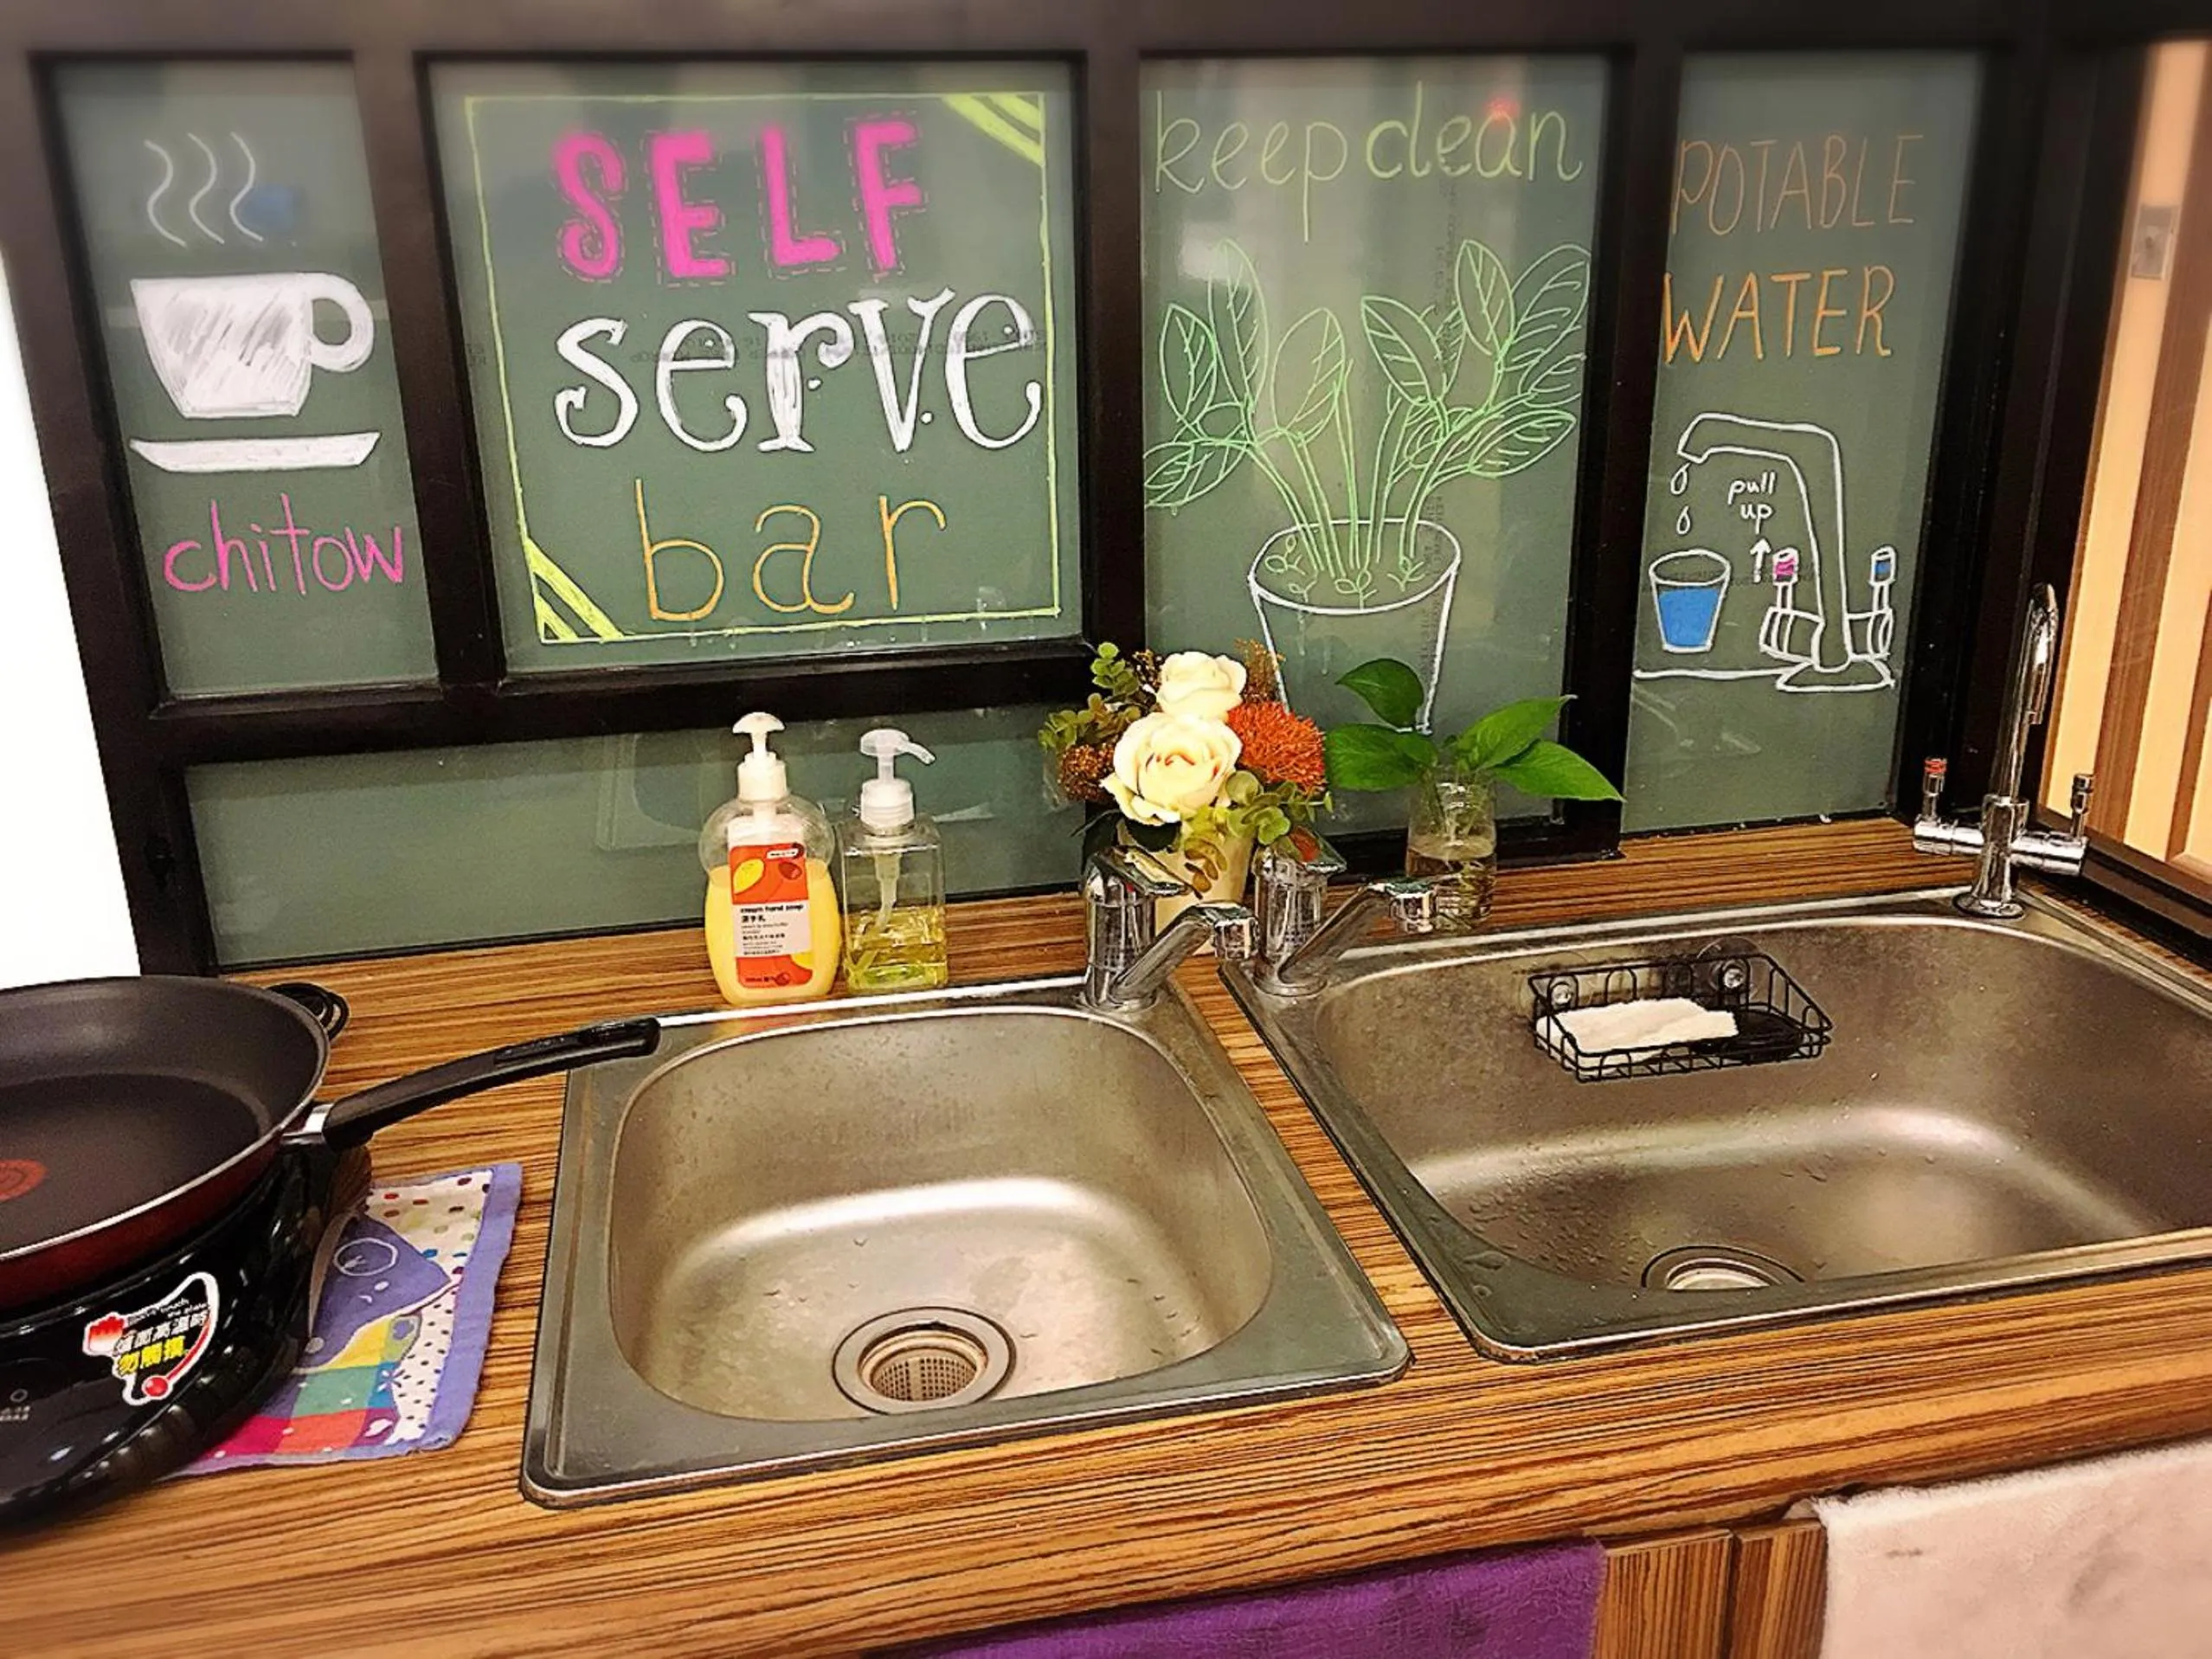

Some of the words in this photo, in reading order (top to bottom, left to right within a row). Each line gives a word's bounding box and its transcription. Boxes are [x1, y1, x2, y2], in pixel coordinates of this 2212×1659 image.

[551, 114, 928, 286] SELF
[1154, 89, 1348, 242] keep
[1366, 80, 1583, 183] clean
[1672, 132, 1925, 236] POTABLE
[1663, 265, 1895, 364] WATER
[554, 286, 1042, 452] serve
[1728, 472, 1777, 505] pull
[1740, 502, 1773, 534] up
[163, 493, 405, 596] chitow
[635, 478, 947, 621] bar
